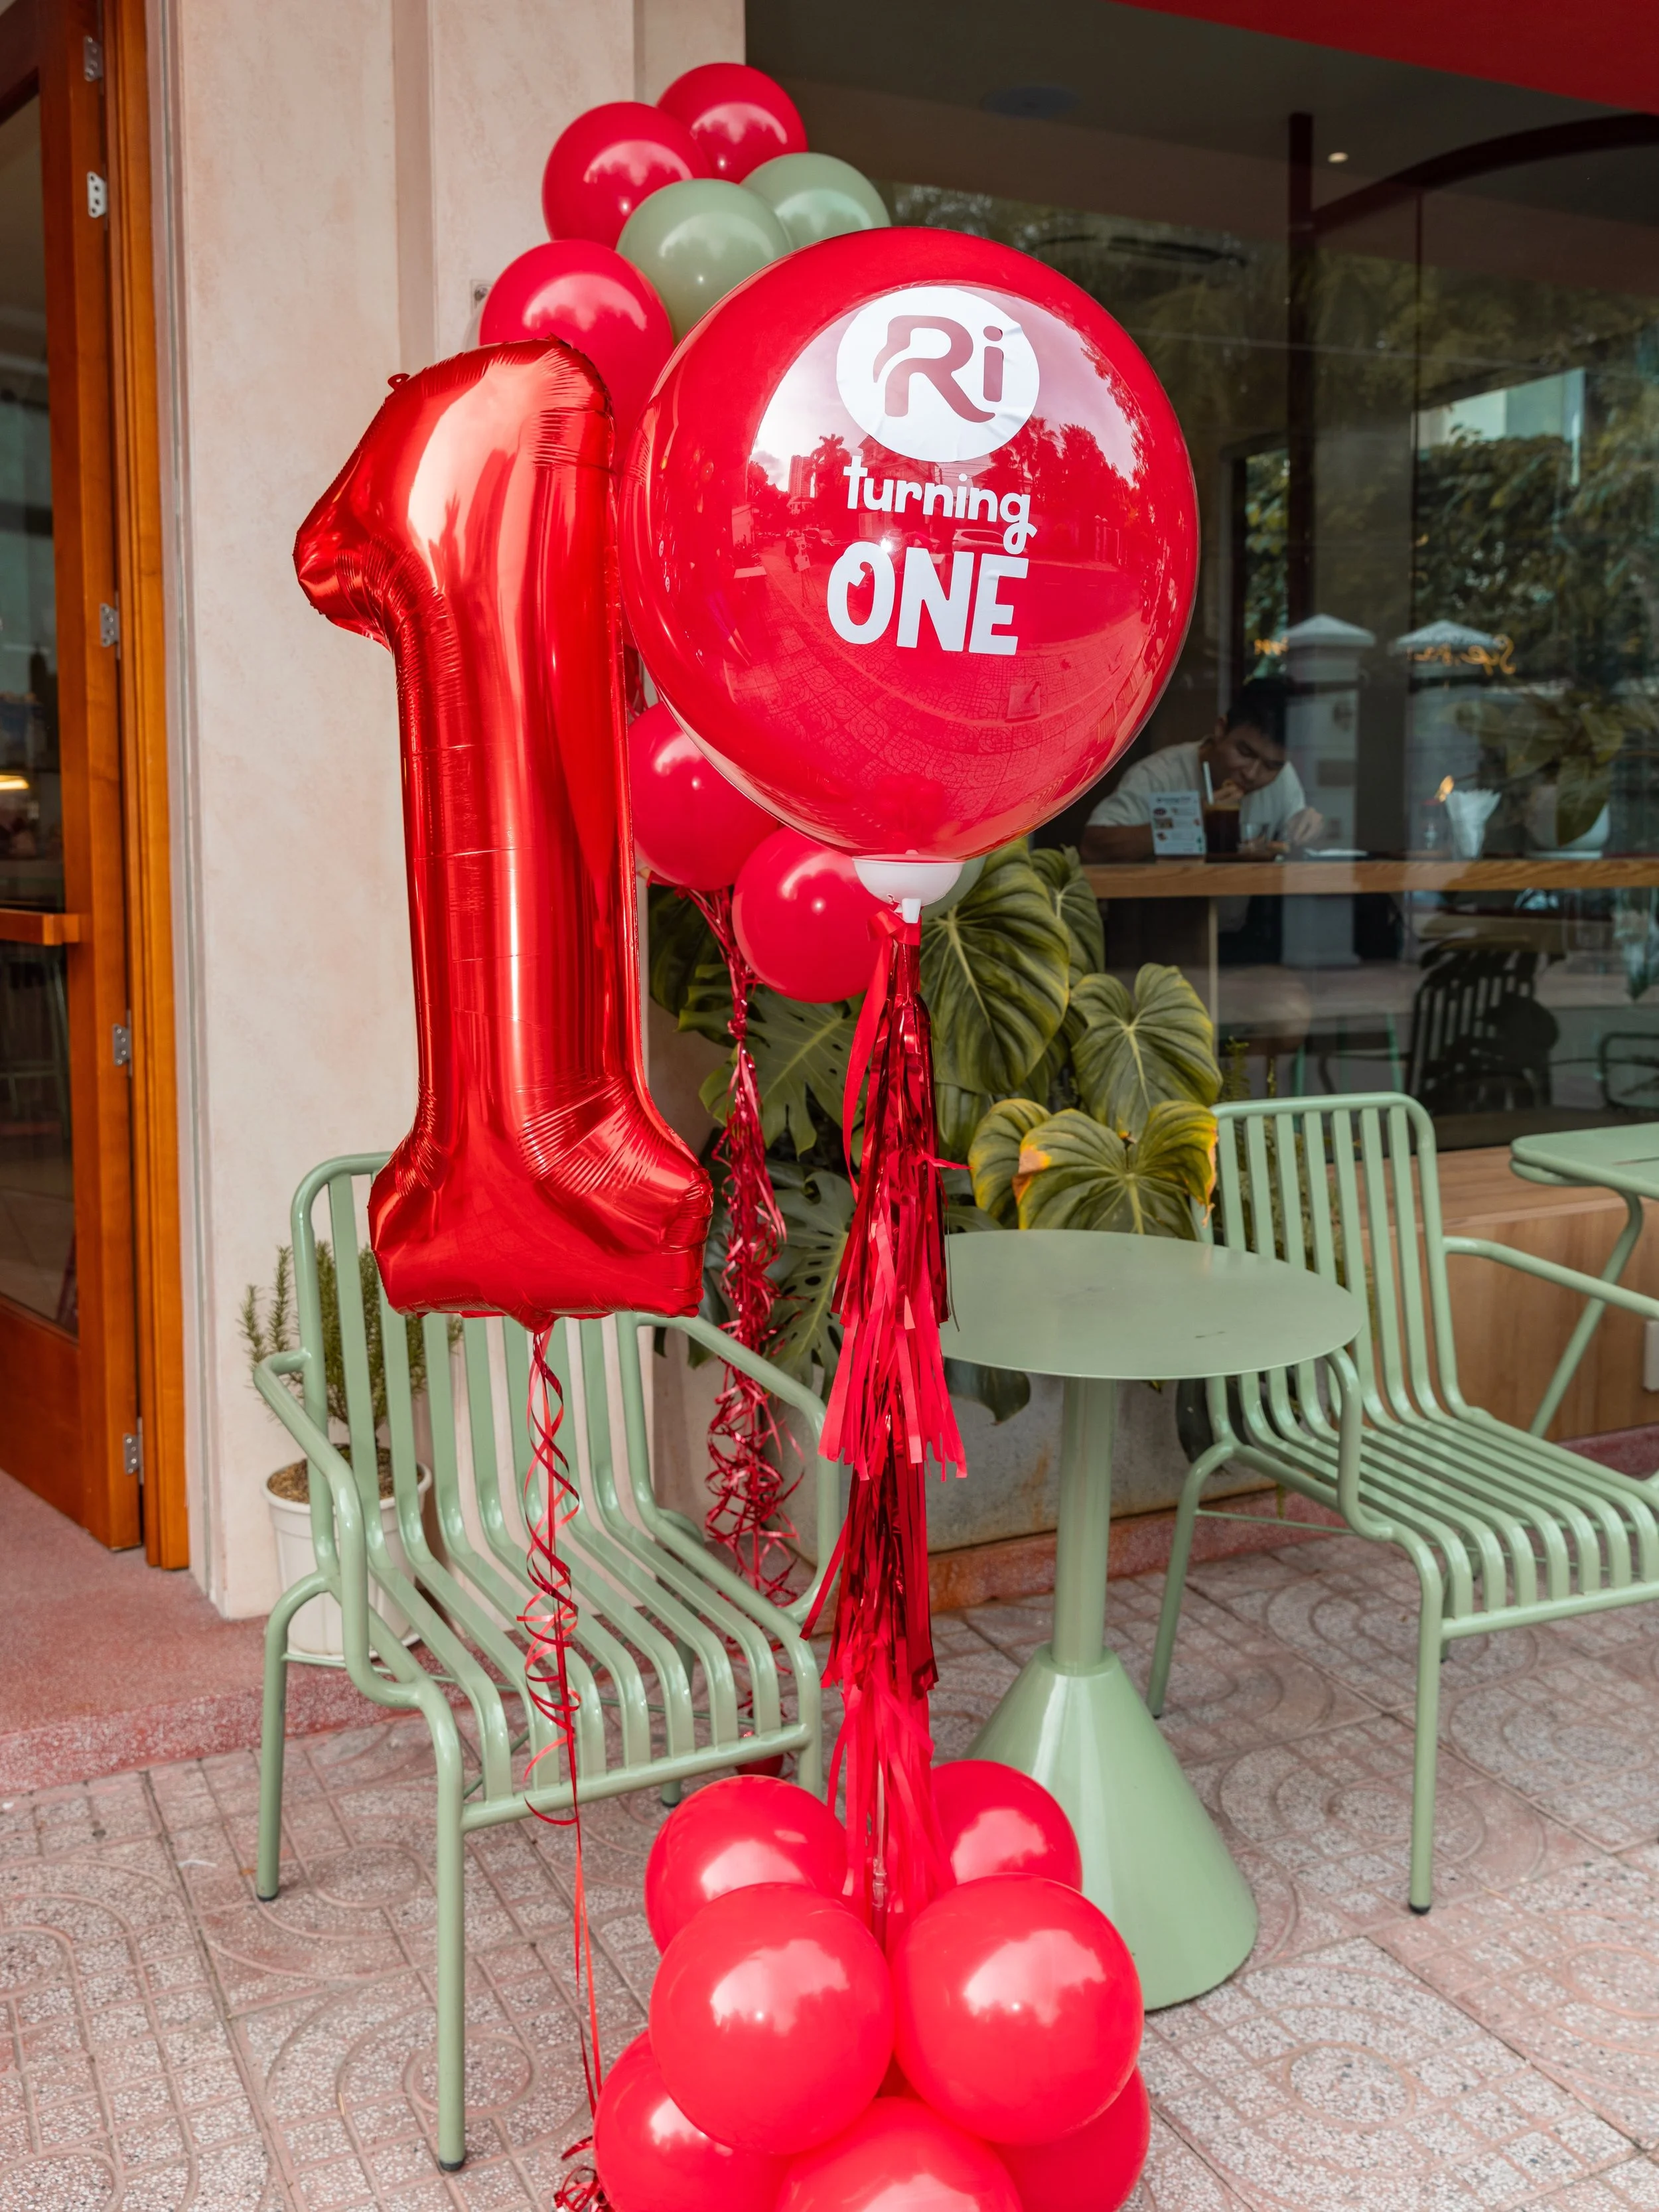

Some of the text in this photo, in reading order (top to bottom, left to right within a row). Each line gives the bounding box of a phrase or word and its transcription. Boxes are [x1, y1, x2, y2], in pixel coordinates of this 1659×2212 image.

[873, 315, 1004, 423] Ri
[843, 455, 1037, 555] turning
[827, 541, 1029, 655] ONE
[293, 338, 713, 1316] 1
